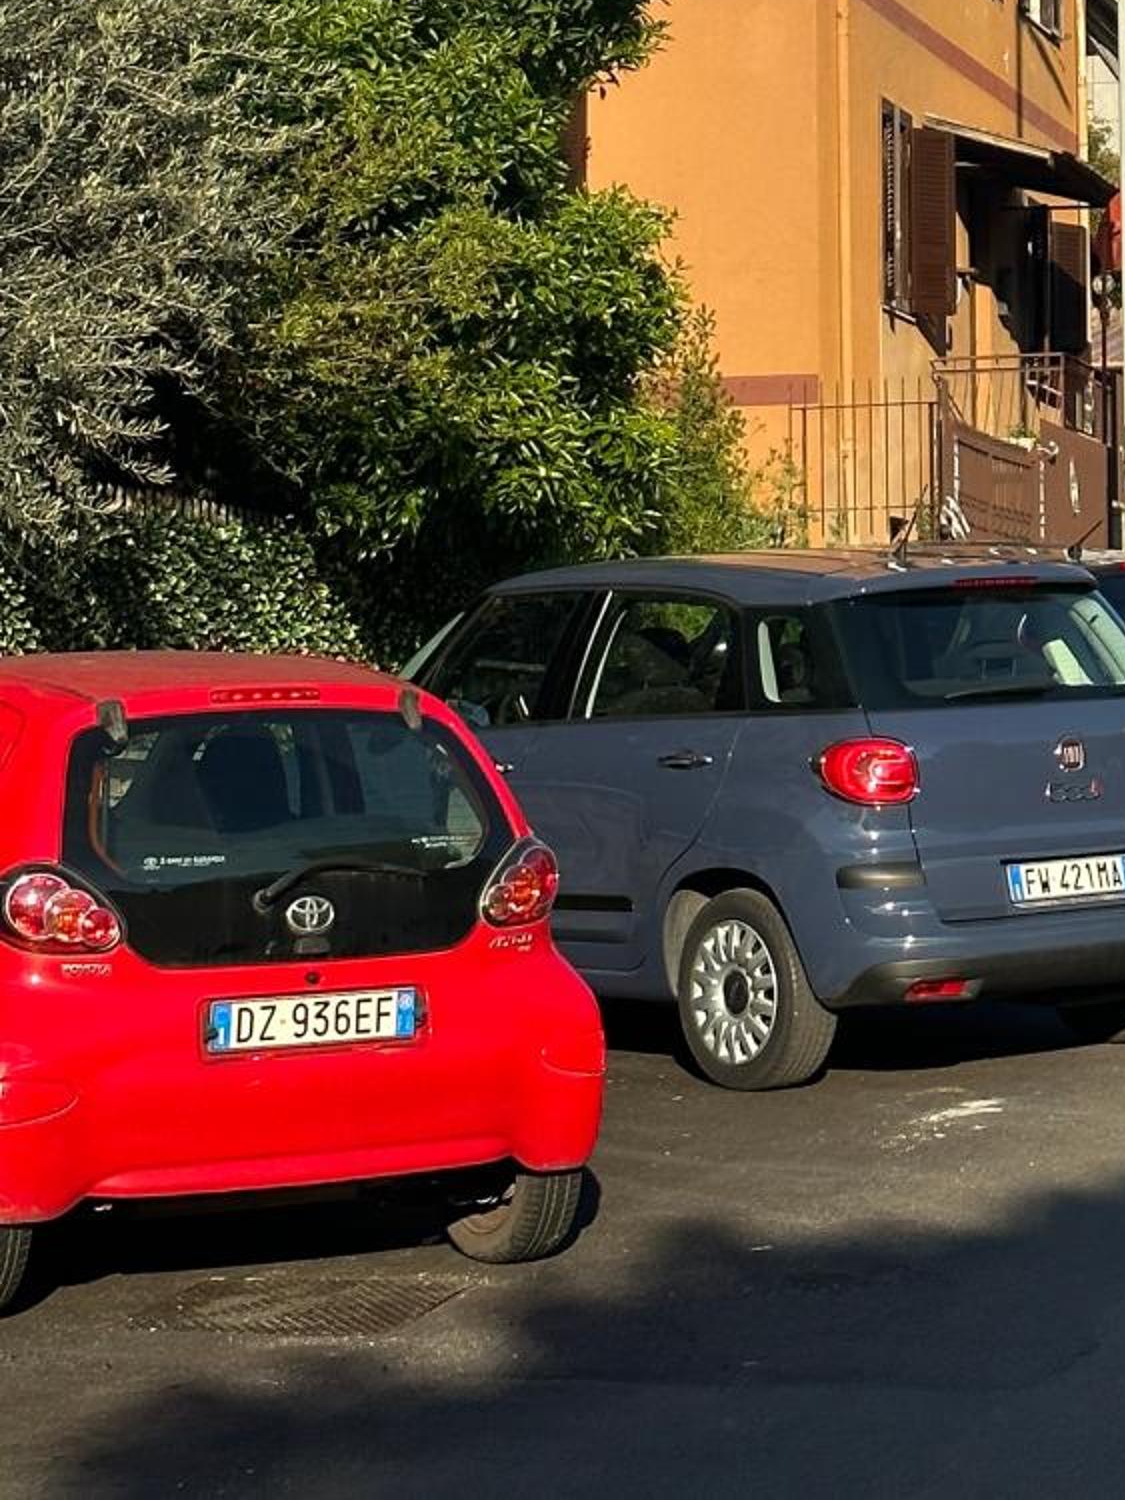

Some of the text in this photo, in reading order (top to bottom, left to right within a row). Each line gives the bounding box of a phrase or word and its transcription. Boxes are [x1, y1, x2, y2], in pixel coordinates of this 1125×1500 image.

[1025, 861, 1123, 895] FW 421MA
[236, 996, 393, 1043] DZ 936EF
